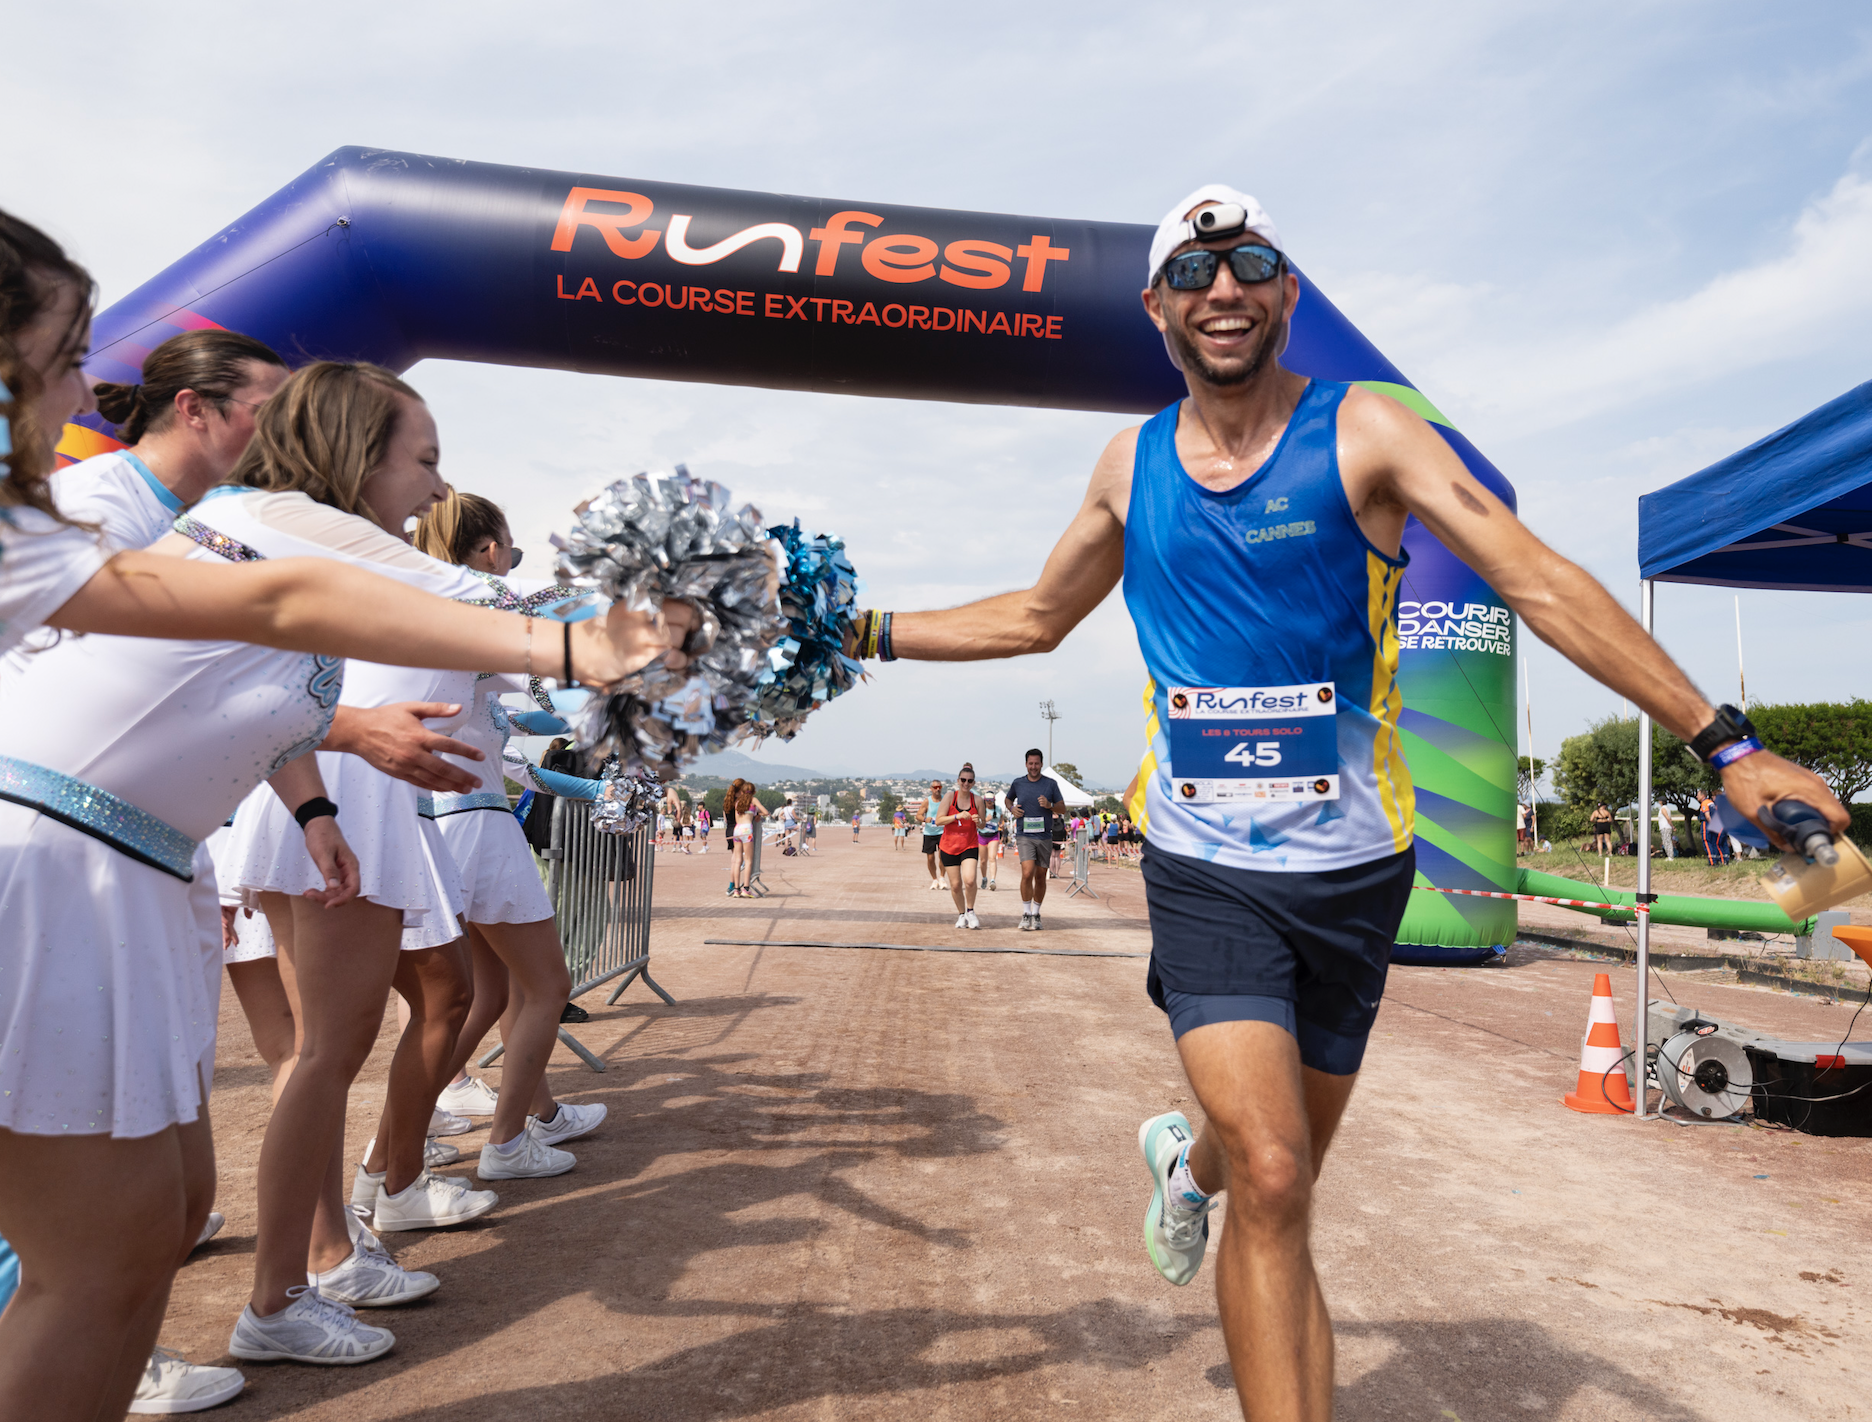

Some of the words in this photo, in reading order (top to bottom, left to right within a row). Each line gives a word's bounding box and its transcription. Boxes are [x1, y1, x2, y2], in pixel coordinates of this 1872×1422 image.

[550, 186, 1070, 293] Runfest
[556, 274, 603, 303] LA
[612, 279, 756, 317] COURSE
[764, 294, 1064, 340] EXTRAORDINAIRE
[1264, 496, 1289, 514] AC
[1245, 520, 1317, 544] CANNES
[1398, 601, 1511, 626] COURIR
[1397, 619, 1511, 642] DANSER
[1398, 636, 1418, 649] SE
[1421, 636, 1511, 656] RETROUVER
[1196, 692, 1308, 709] Runfest
[1232, 728, 1270, 736] TOURS
[1272, 727, 1303, 735] SOLO
[1224, 741, 1282, 767] 45
